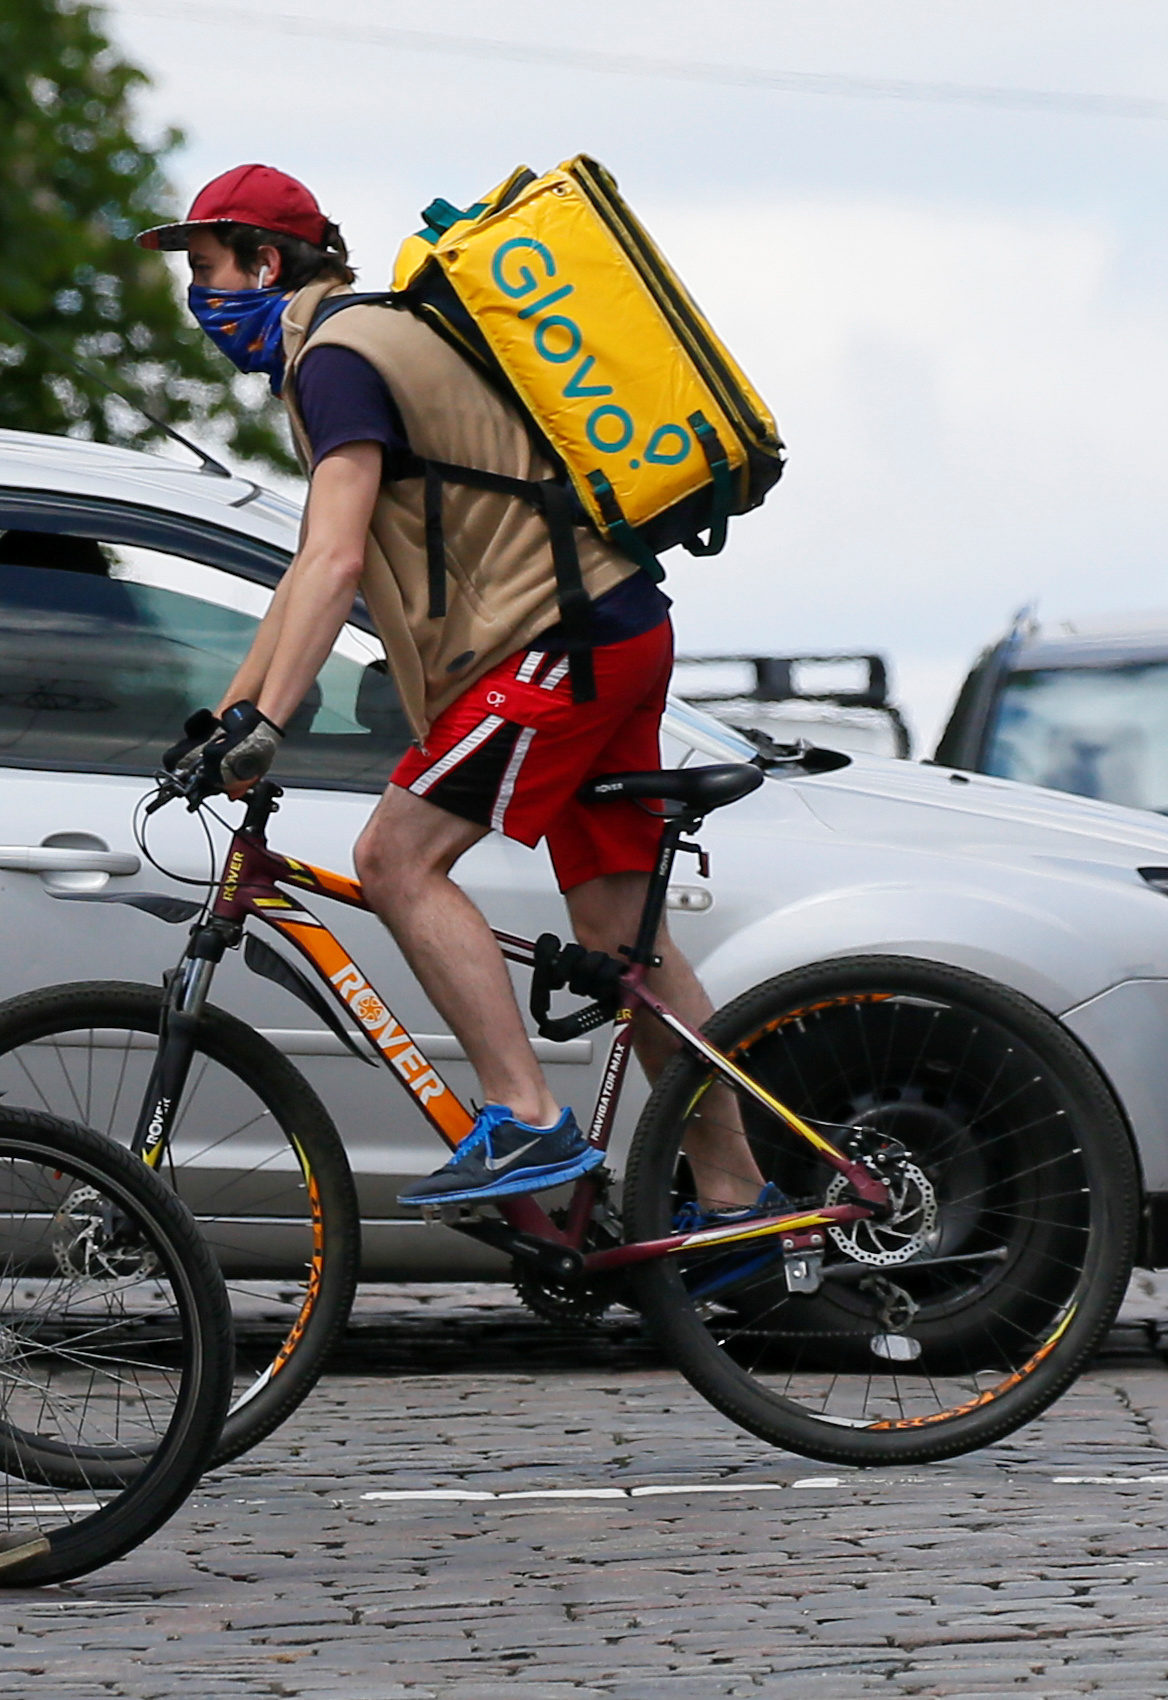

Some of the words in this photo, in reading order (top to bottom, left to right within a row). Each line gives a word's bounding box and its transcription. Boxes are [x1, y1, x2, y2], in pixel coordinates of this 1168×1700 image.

[490, 236, 635, 454] Glovo
[222, 851, 245, 901] ROVER
[329, 962, 446, 1105] ROVER
[590, 1072, 617, 1142] NAVIGATOR
[609, 1042, 626, 1072] MAX
